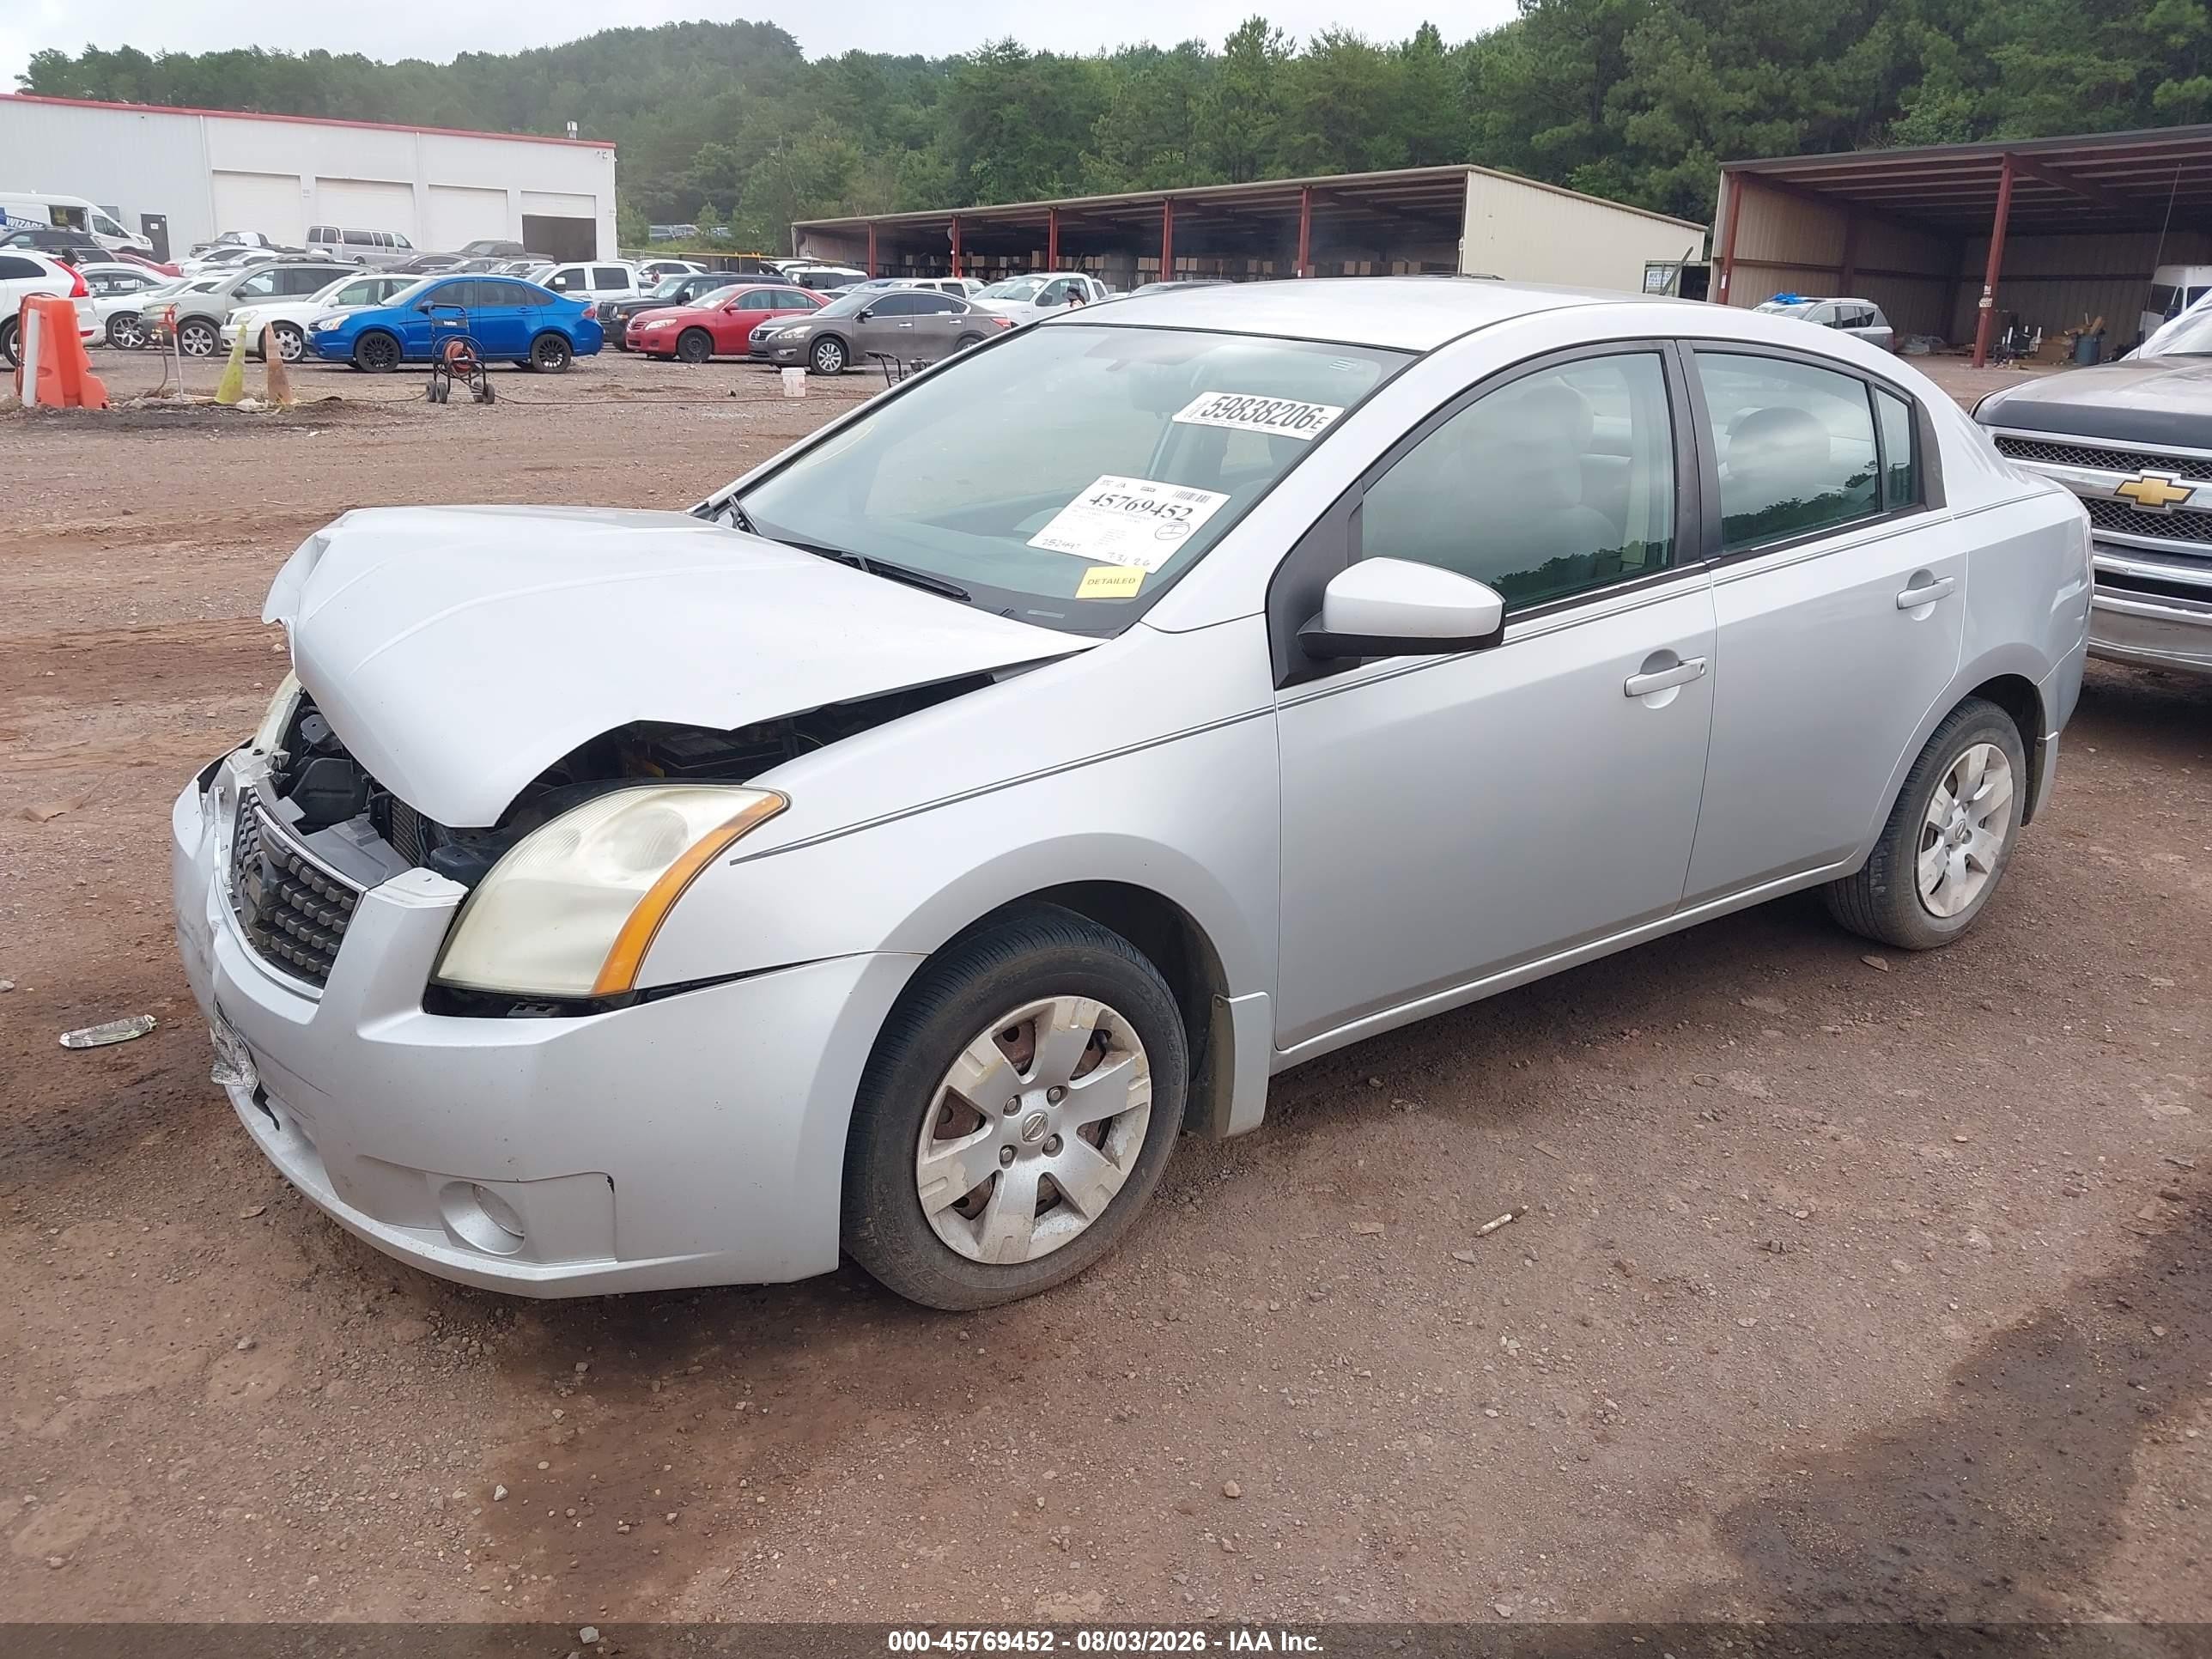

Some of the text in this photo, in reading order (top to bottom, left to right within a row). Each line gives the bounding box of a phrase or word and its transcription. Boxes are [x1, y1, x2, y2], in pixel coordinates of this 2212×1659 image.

[1200, 396, 1325, 429] 59838206
[1310, 416, 1329, 429] E
[1089, 492, 1194, 521] 45769452
[1086, 577, 1136, 586] DETAILED
